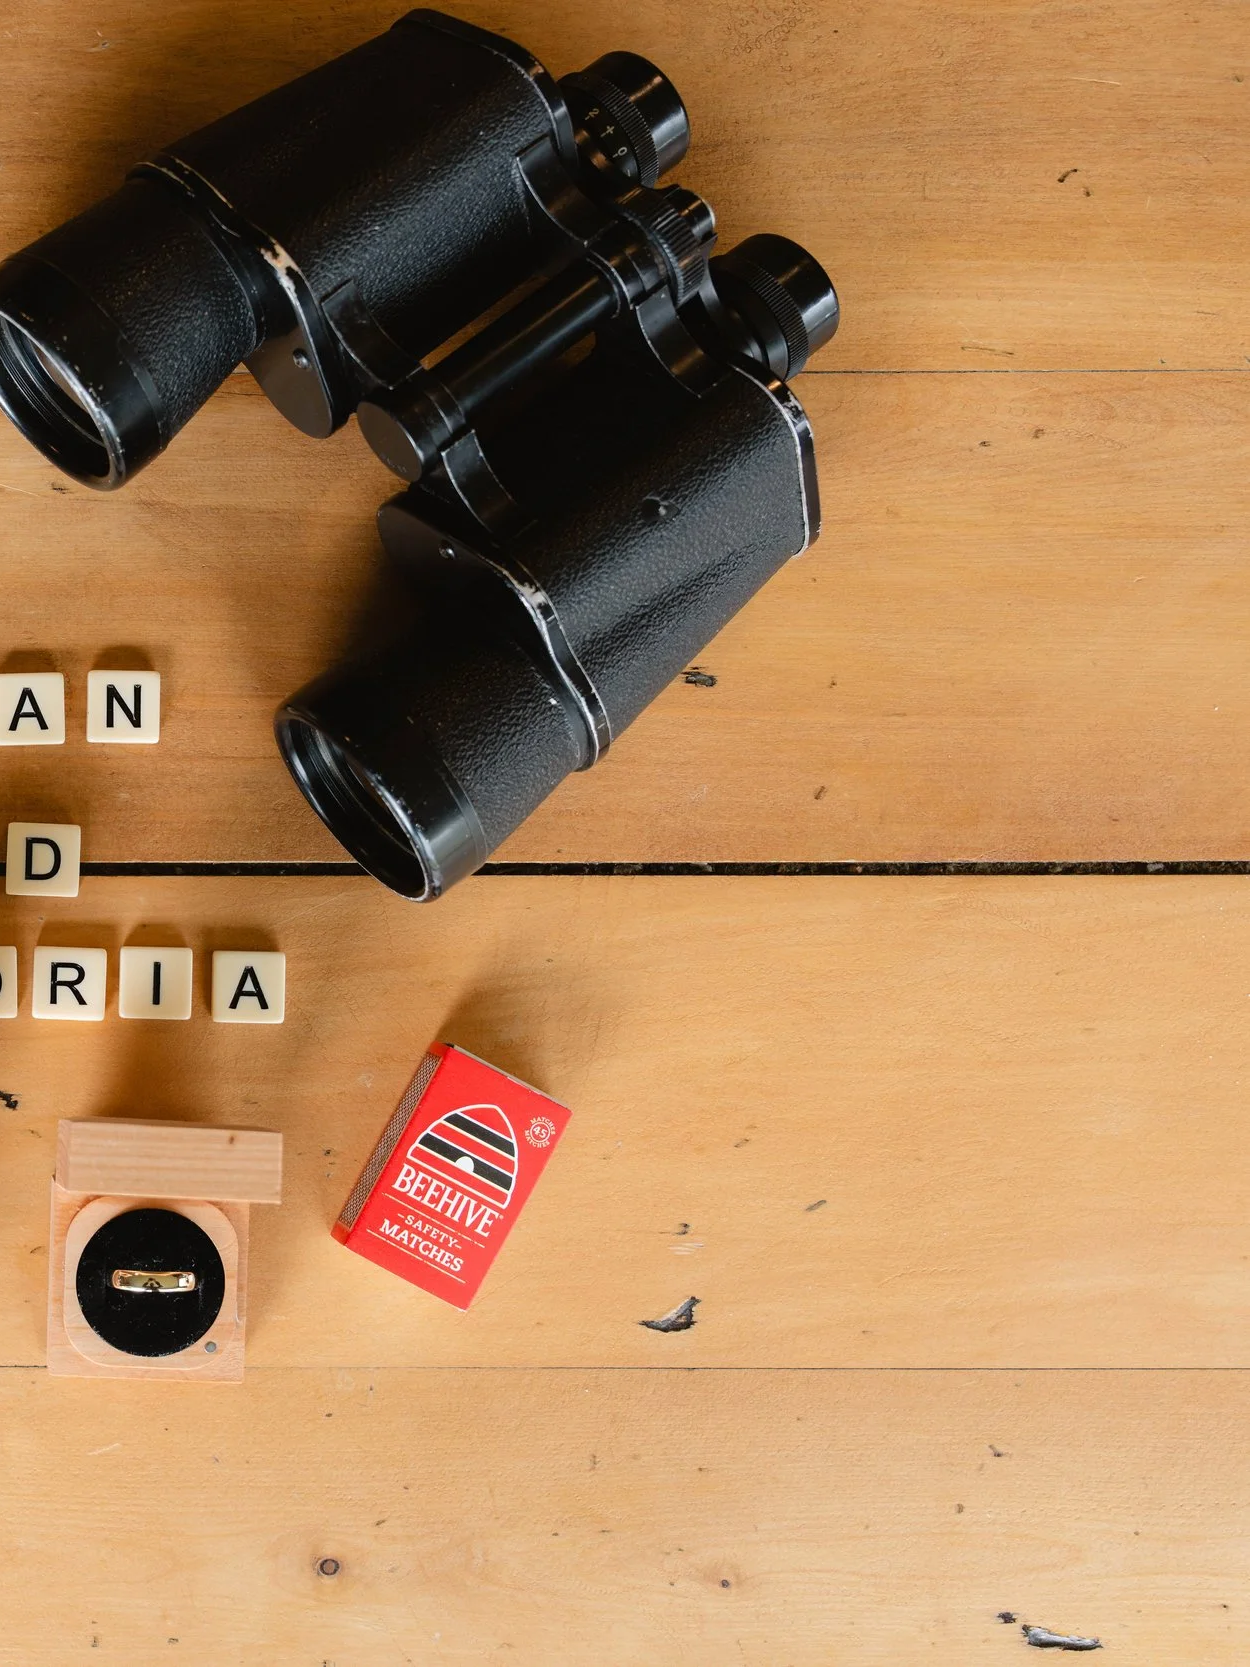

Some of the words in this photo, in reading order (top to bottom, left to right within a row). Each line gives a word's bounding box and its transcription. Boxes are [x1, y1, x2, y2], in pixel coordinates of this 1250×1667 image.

[524, 1129, 550, 1148] MATCHES
[529, 1116, 556, 1135] MATCHES
[532, 1126, 548, 1138] 45
[391, 1163, 500, 1238] BEEHIVE
[404, 1214, 458, 1249] SAFETY
[379, 1219, 464, 1272] MATCHES
